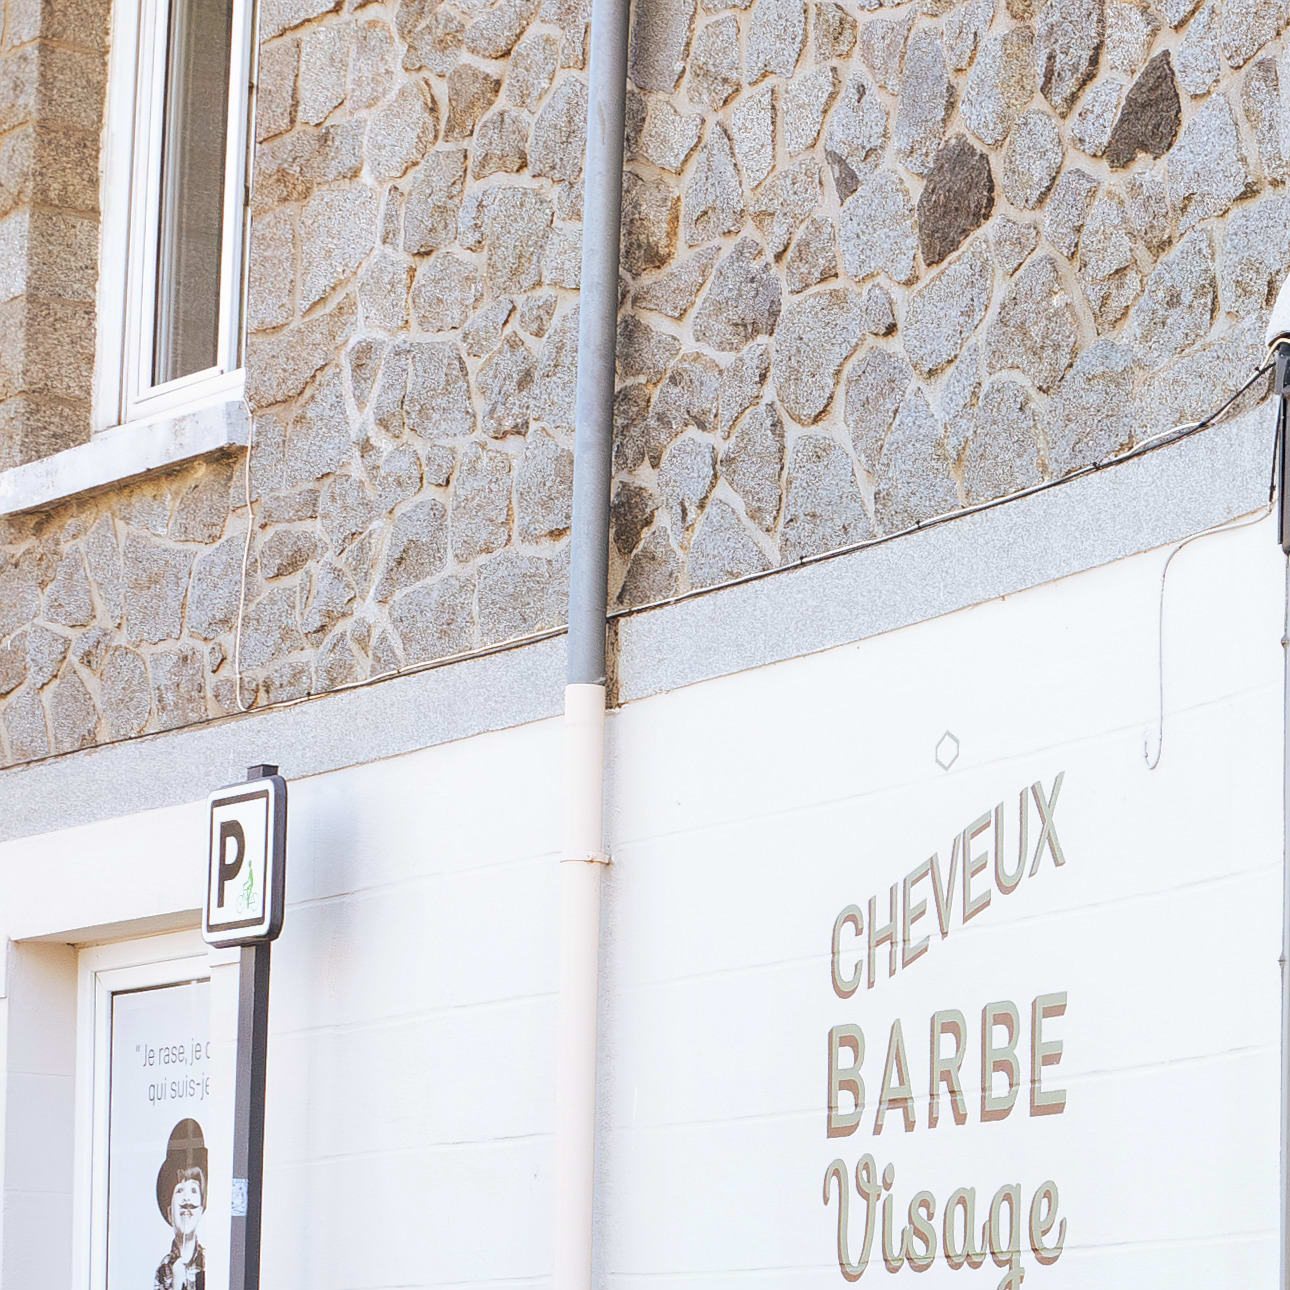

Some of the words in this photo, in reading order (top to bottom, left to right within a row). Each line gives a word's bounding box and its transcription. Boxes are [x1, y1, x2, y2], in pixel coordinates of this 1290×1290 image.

[217, 819, 246, 908] P
[830, 770, 1066, 999] CHEVEUX
[148, 1077, 167, 1106] qui
[158, 1043, 188, 1065] rase,
[190, 1037, 202, 1066] je
[827, 991, 1068, 1139] BARBE
